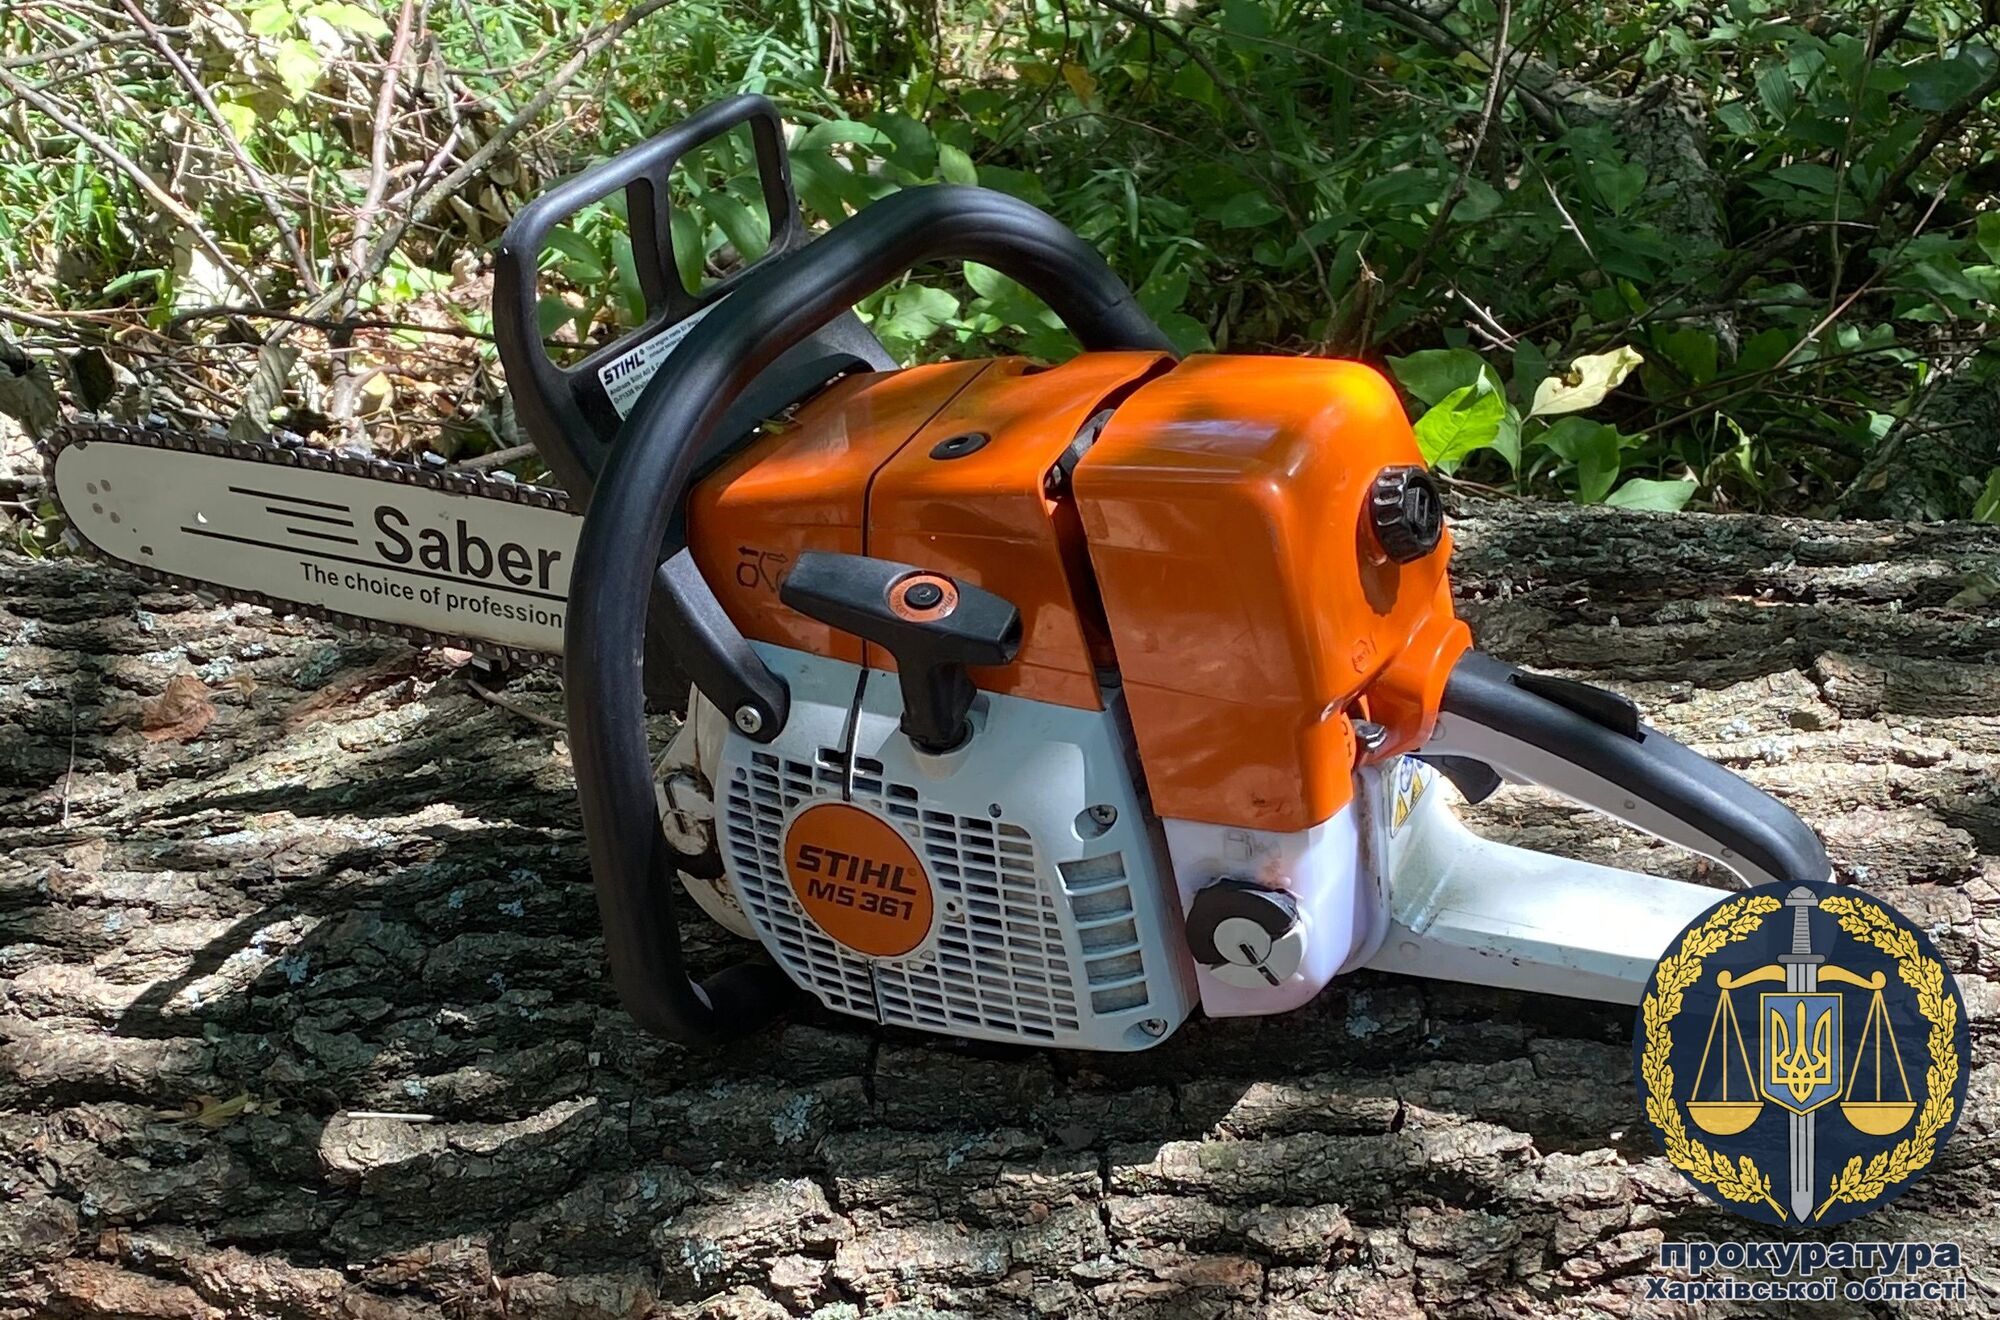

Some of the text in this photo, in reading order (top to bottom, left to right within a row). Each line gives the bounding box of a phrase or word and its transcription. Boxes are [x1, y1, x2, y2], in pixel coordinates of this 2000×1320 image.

[603, 352, 645, 386] STIHL
[610, 381, 631, 396] Andreas
[373, 505, 562, 590] Saber
[299, 561, 562, 628] The choice of profession
[796, 844, 917, 896] STIHL
[807, 878, 914, 921] MS 361
